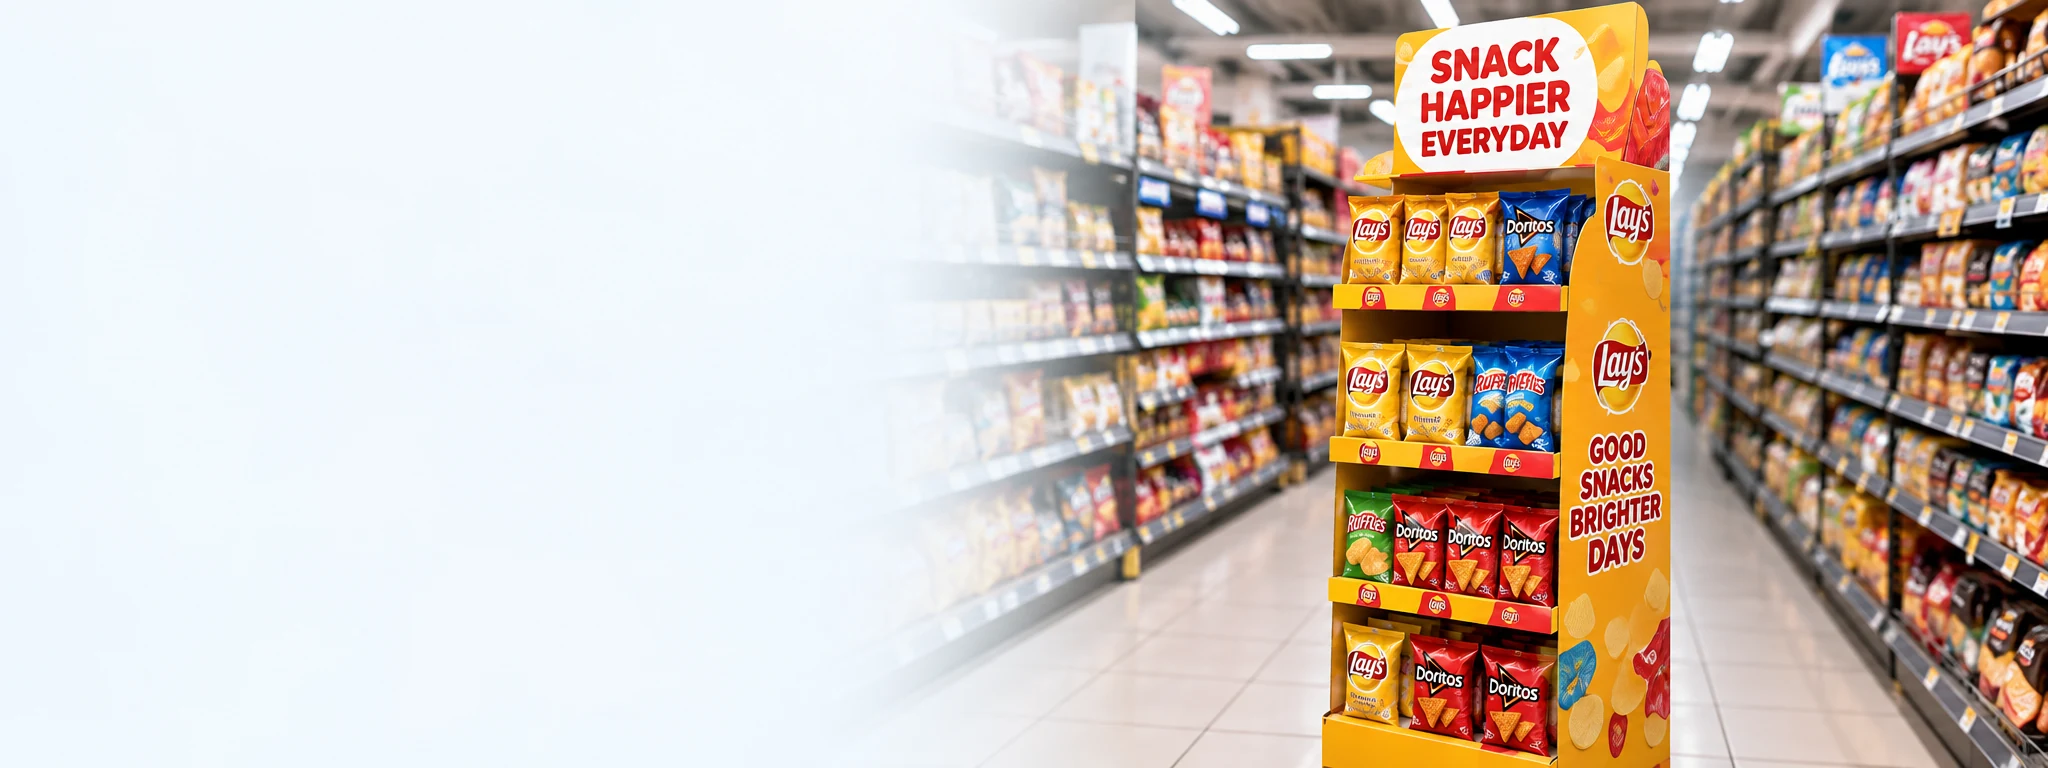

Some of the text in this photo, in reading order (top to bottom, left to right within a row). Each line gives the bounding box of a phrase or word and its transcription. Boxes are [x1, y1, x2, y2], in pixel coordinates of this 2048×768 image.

[1431, 37, 1559, 84] SNACK
[1421, 80, 1570, 123] HAPPIER
[1421, 121, 1568, 157] EVERYDAY
[1506, 219, 1554, 234] Doritos
[1609, 197, 1651, 243] Lay's
[1598, 344, 1644, 391] Lay's
[1589, 432, 1646, 465] GOOD
[1580, 463, 1654, 500] SNACKS
[1396, 523, 1438, 541] Doritos
[1570, 494, 1662, 540] BRIGHTER
[1449, 529, 1491, 547] Doritos
[1504, 535, 1546, 554] Doritos
[1587, 528, 1645, 575] DAYS
[1416, 666, 1463, 688] Doritos
[1489, 678, 1538, 700] Doritos
